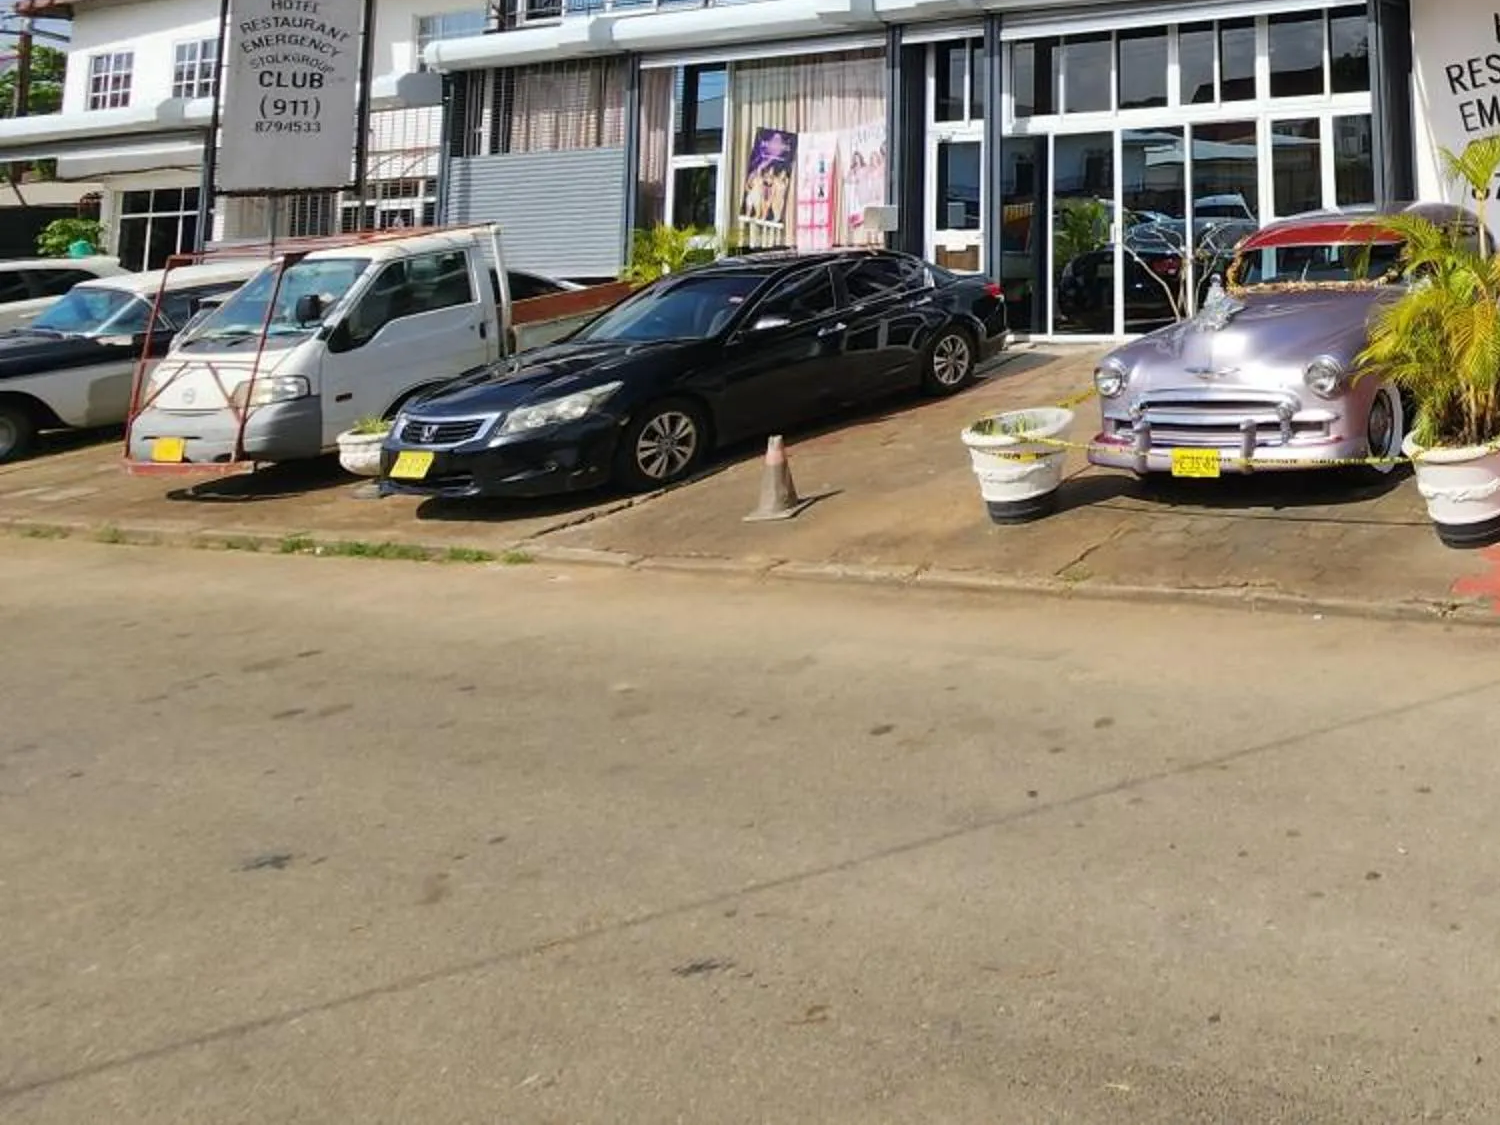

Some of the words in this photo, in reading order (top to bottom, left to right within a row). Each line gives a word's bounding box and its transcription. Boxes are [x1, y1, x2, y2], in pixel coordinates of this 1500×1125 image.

[240, 16, 351, 42] RESTAURANT
[241, 33, 343, 57] EMERGENCY
[259, 70, 324, 89] CLUB
[260, 94, 321, 119] (911)
